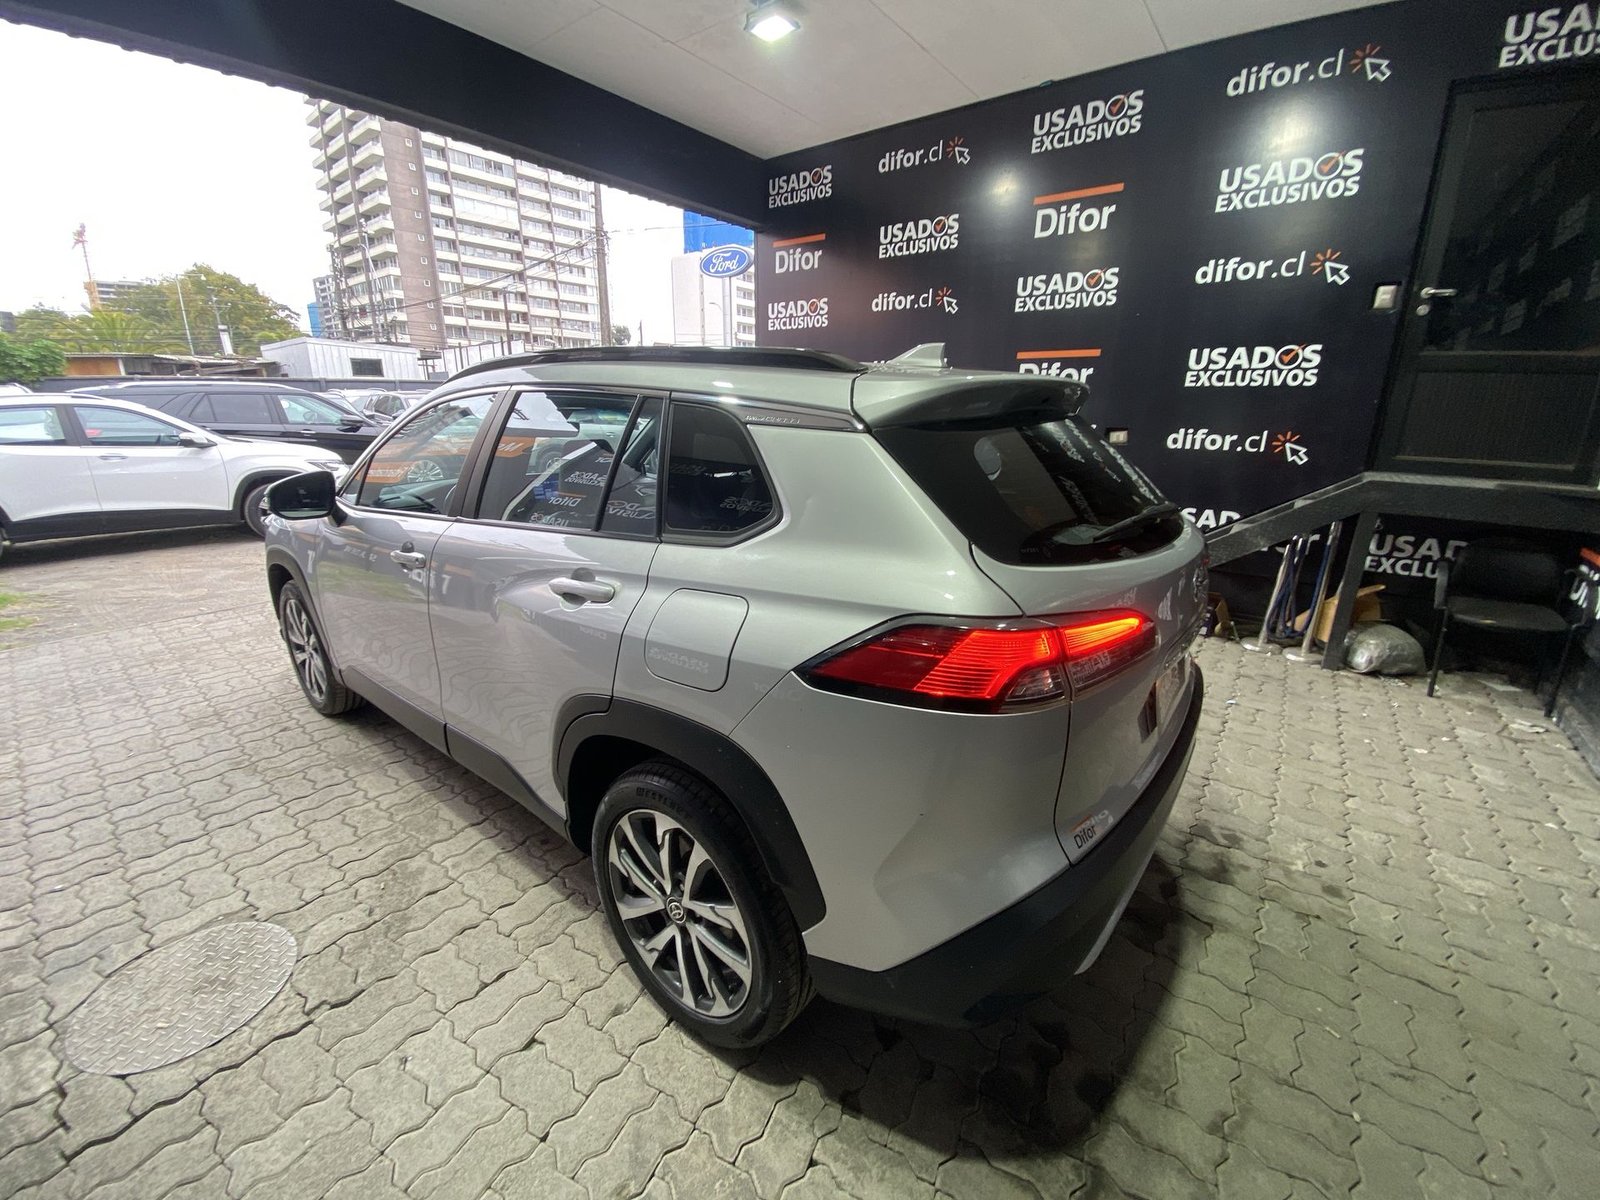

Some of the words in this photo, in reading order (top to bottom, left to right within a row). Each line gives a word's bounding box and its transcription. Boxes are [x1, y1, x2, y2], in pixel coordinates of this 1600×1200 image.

[1504, 3, 1600, 44] USA
[1226, 48, 1345, 97] difor.cl
[1033, 90, 1144, 136] USADOS
[1031, 115, 1142, 154] EXCLUSIVOS
[878, 140, 943, 173] difor.cl
[1219, 148, 1365, 193] USADOS
[768, 165, 833, 195] USADOS
[768, 184, 833, 209] EXCLUSIVOS
[1214, 176, 1361, 213] EXCLUSIVOS
[879, 214, 960, 245] USADOS
[1034, 203, 1117, 239] Difor
[878, 234, 959, 259] EXCLUSIVOS
[709, 252, 740, 273] Ford
[775, 248, 823, 274] Difor
[1195, 251, 1306, 284] difor.cl
[1016, 267, 1120, 297] USADOS
[768, 298, 829, 319] USADOS
[871, 288, 933, 313] difor.cl
[1014, 290, 1118, 313] EXCLUSIVOS
[767, 315, 829, 331] EXCLUSIVOS
[1188, 343, 1324, 371] USADOS
[1184, 368, 1319, 388] EXCLUSIVOS
[1166, 428, 1269, 453] difor.cl
[1180, 507, 1241, 529] SAD
[1368, 533, 1470, 562] USAD
[1364, 556, 1440, 579] EXCLU
[1073, 824, 1097, 849] Difor
